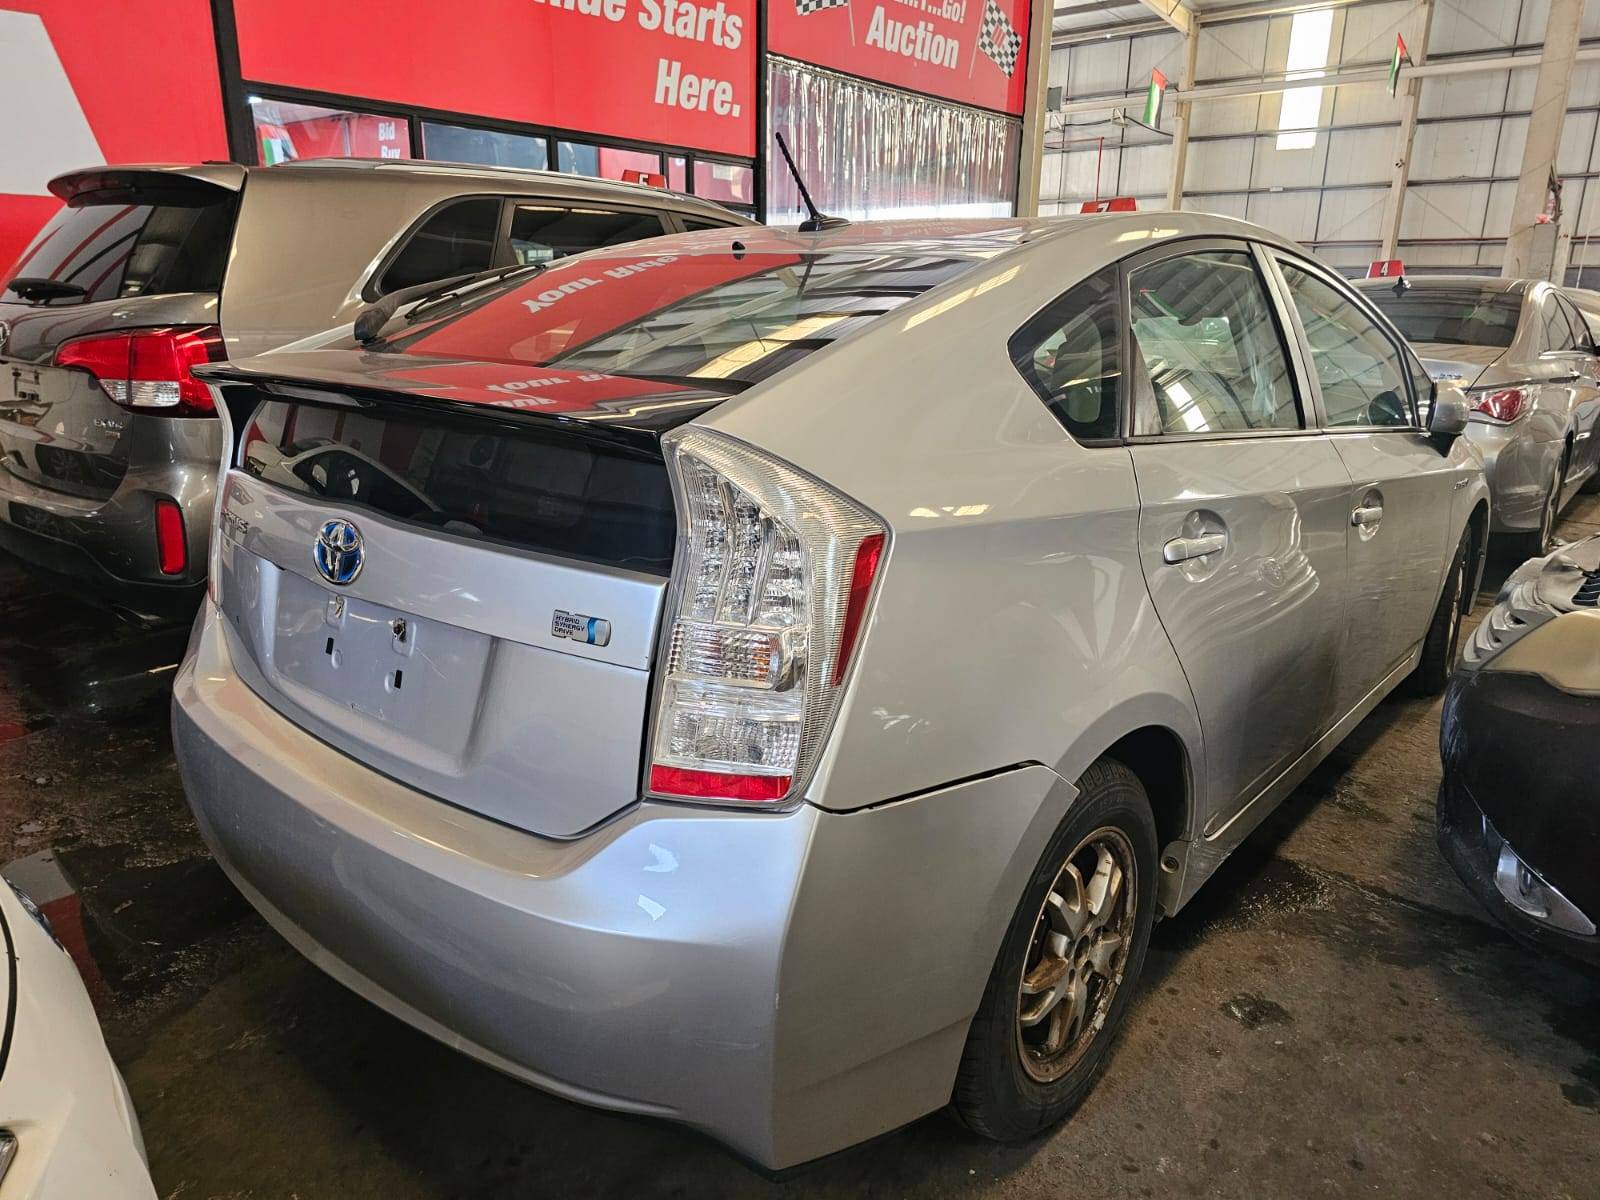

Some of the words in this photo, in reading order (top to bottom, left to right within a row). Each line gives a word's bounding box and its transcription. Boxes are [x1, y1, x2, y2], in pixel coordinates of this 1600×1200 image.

[638, 0, 743, 50] Starts
[865, 5, 960, 70] Auction
[654, 58, 742, 117] Here.
[378, 121, 396, 141] Bid
[1380, 261, 1390, 276] 4
[554, 620, 586, 632] SYNERGY
[555, 614, 580, 625] HYBRID
[553, 626, 574, 636] DRIVE
